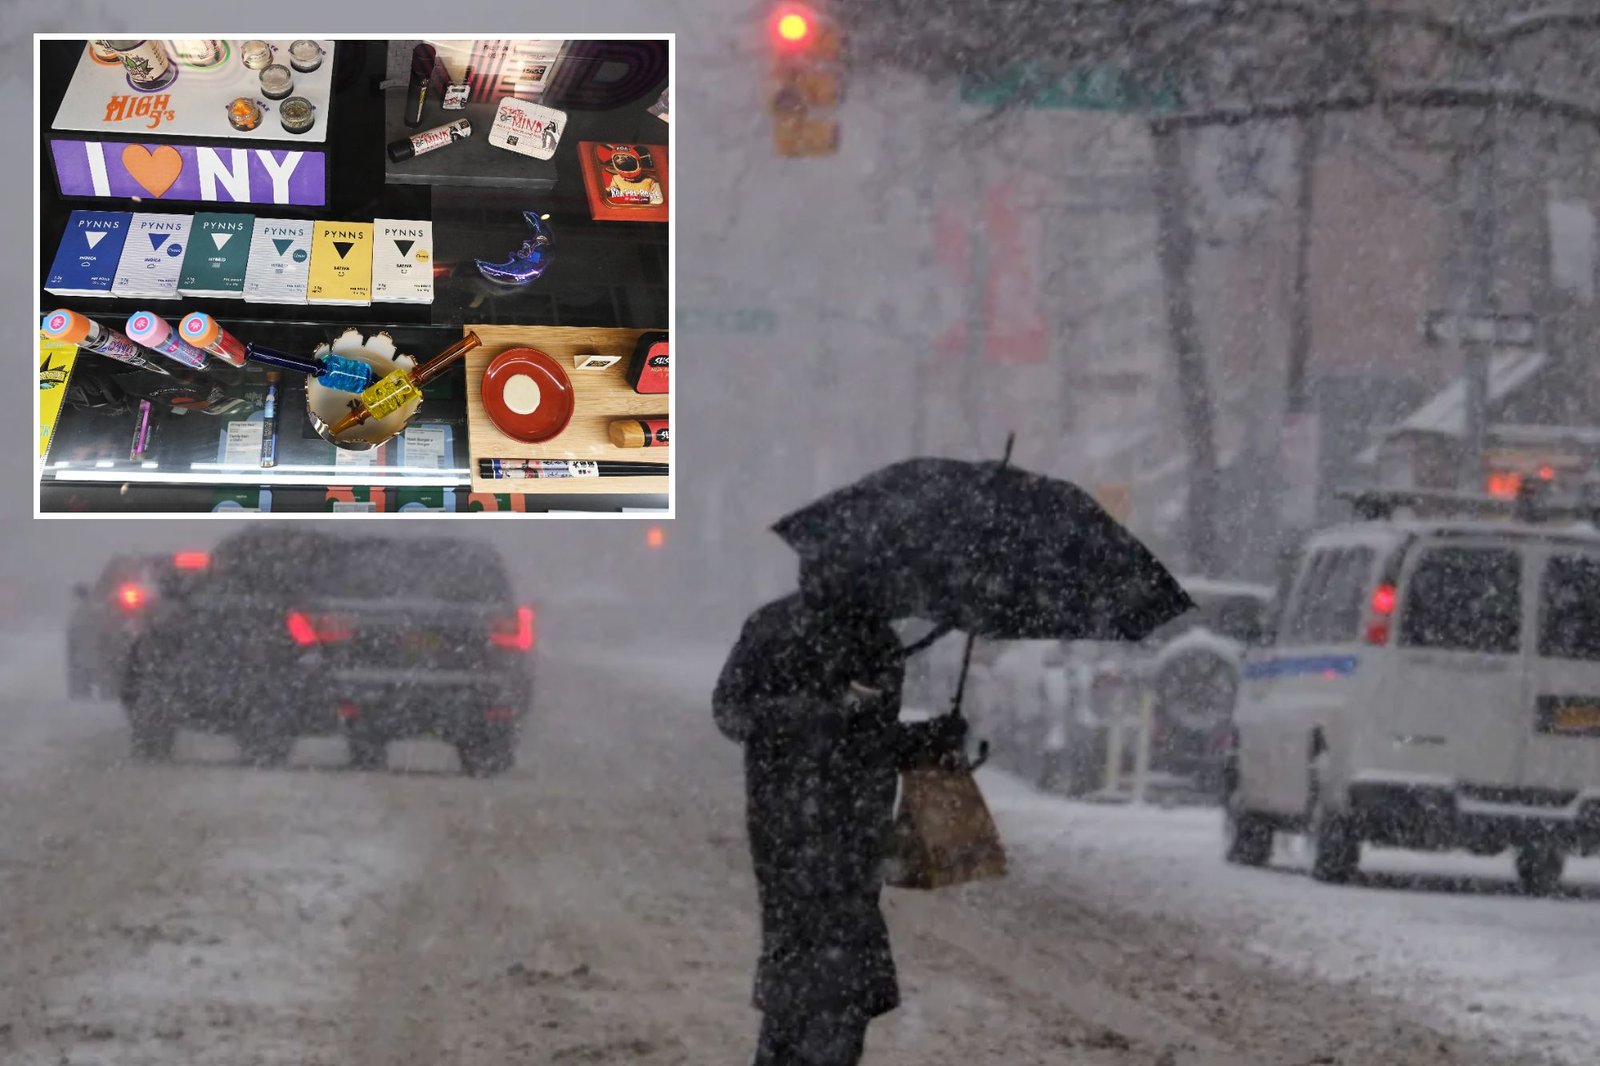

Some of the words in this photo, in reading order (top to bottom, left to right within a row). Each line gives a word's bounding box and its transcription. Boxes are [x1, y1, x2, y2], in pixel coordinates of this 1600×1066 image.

[103, 94, 172, 121] HIGH
[512, 115, 543, 133] MIND
[85, 142, 111, 197] I
[196, 147, 304, 205] NY
[78, 220, 120, 229] PYNNS
[141, 222, 182, 231] PYNNS
[203, 221, 243, 231] PYNNS
[264, 227, 304, 236] PYNNS
[324, 230, 364, 240] PYNNS
[385, 228, 424, 237] PYNNS
